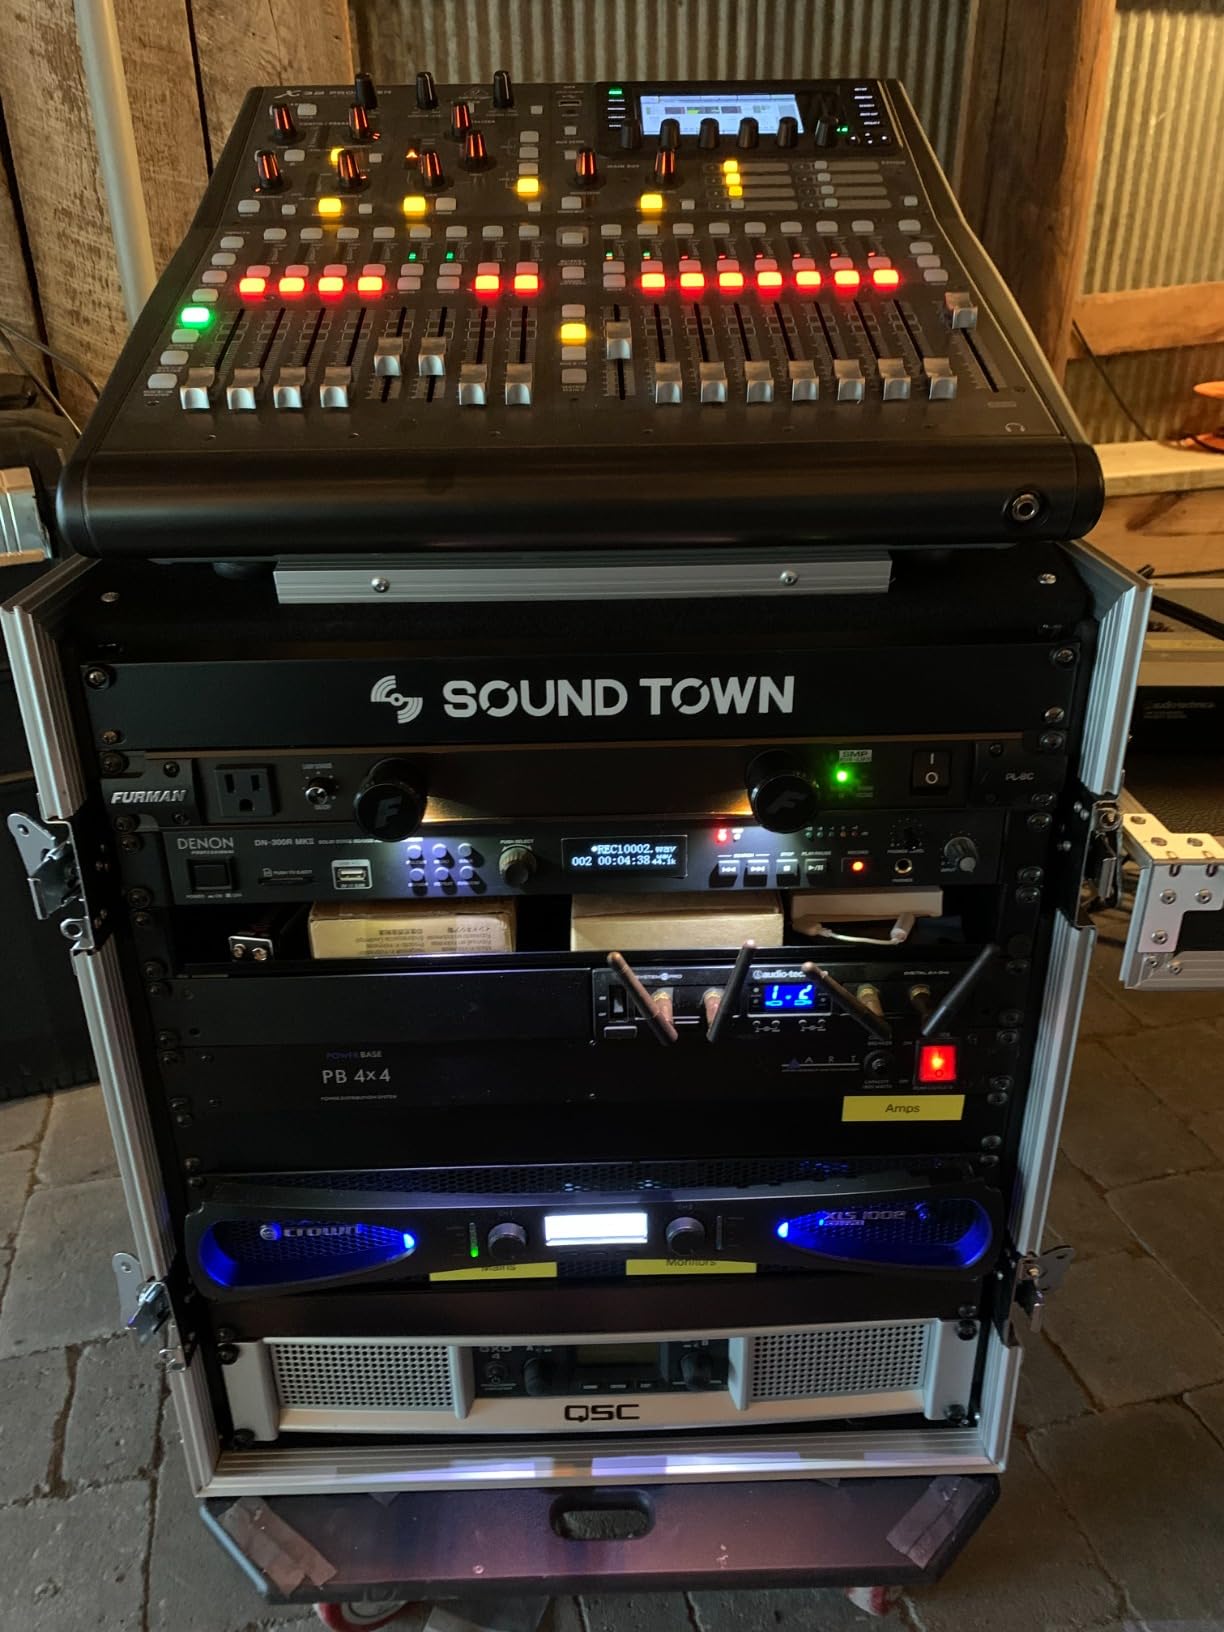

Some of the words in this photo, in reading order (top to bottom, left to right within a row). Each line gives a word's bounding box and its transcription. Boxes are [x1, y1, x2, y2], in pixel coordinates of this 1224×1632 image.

[443, 678, 628, 718] SOUND
[640, 675, 795, 717] TOWN
[110, 789, 187, 805] FURMAN
[176, 837, 234, 850] DENON
[571, 855, 592, 867] 002
[598, 855, 650, 866] 00:04:38
[322, 1069, 347, 1084] PB
[884, 1103, 921, 1114] Amps
[824, 1210, 856, 1221] XLS
[283, 1223, 362, 1237] crown
[564, 1404, 640, 1423] QSC
